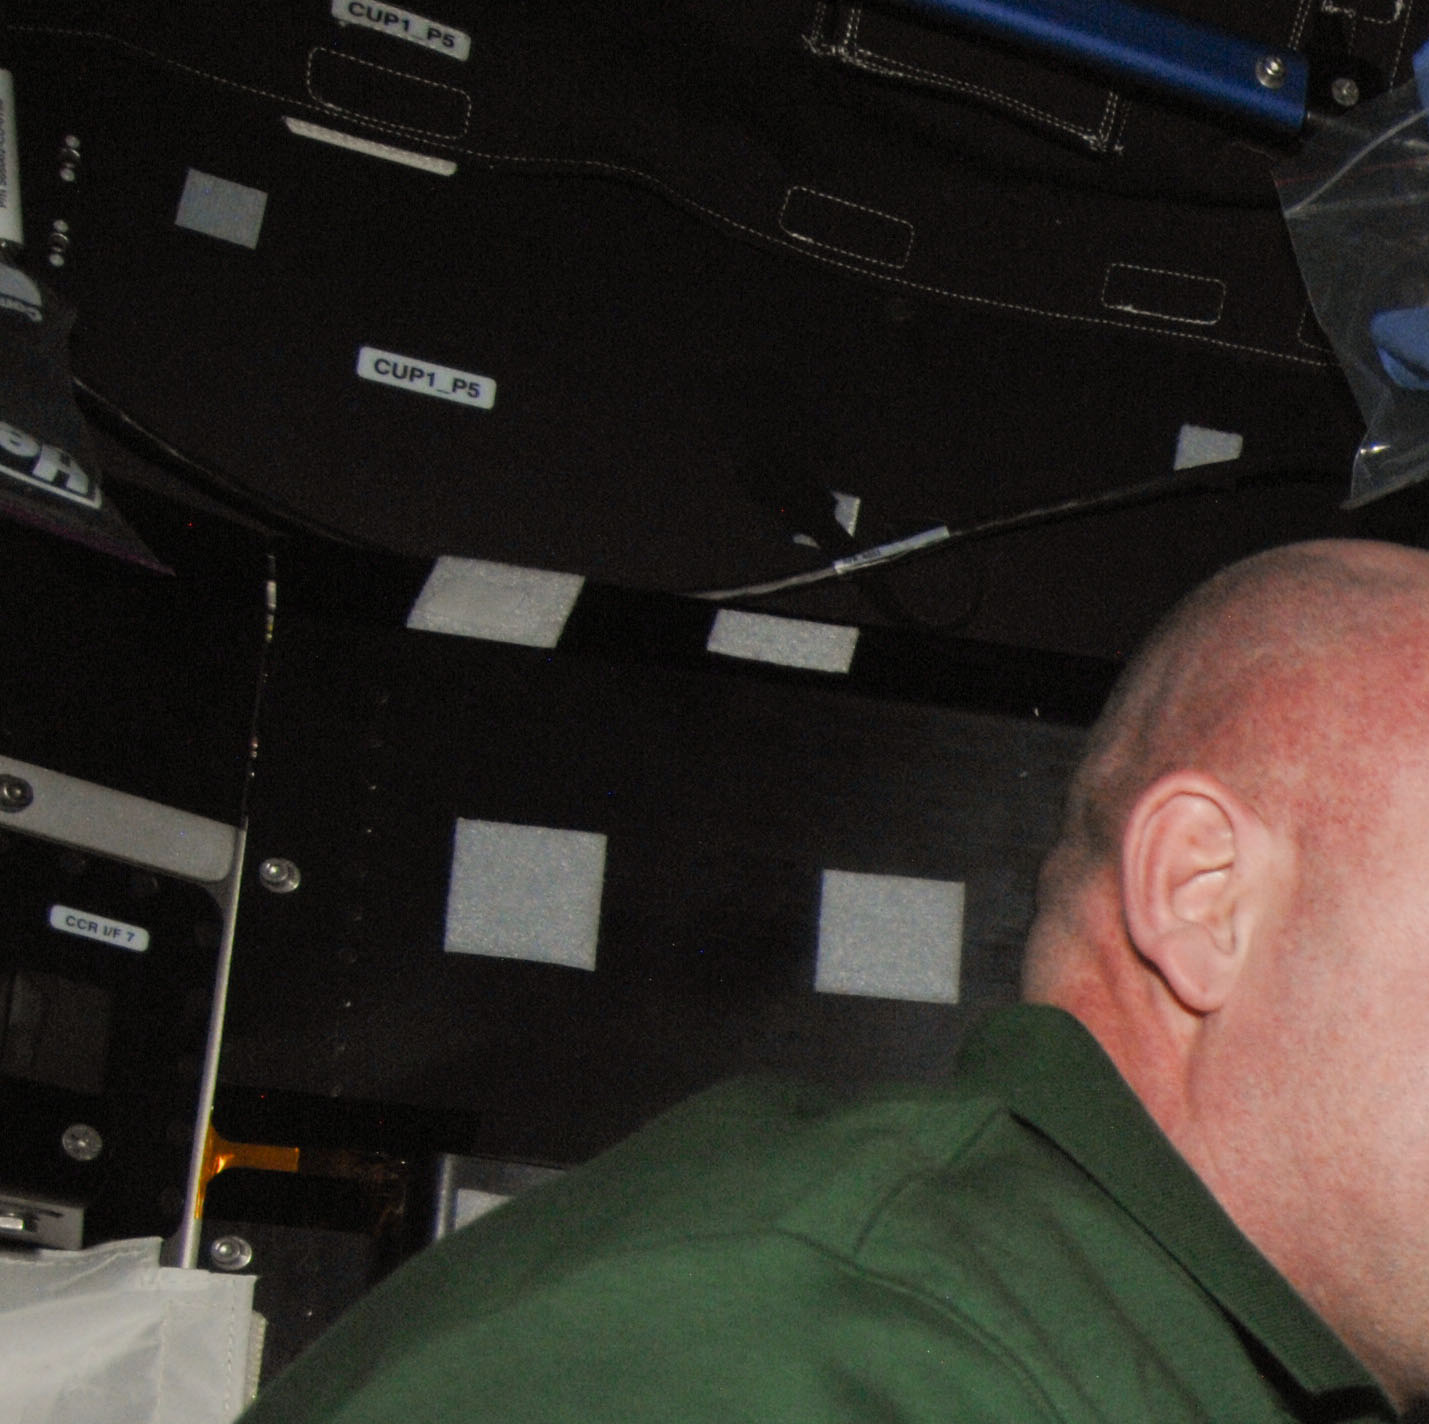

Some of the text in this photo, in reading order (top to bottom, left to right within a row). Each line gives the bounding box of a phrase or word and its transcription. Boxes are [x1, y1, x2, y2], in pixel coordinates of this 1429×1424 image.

[347, 1, 455, 49] CUP1_P5
[373, 357, 481, 398] CUP1_P5
[65, 914, 136, 943] CCR I/F 7
